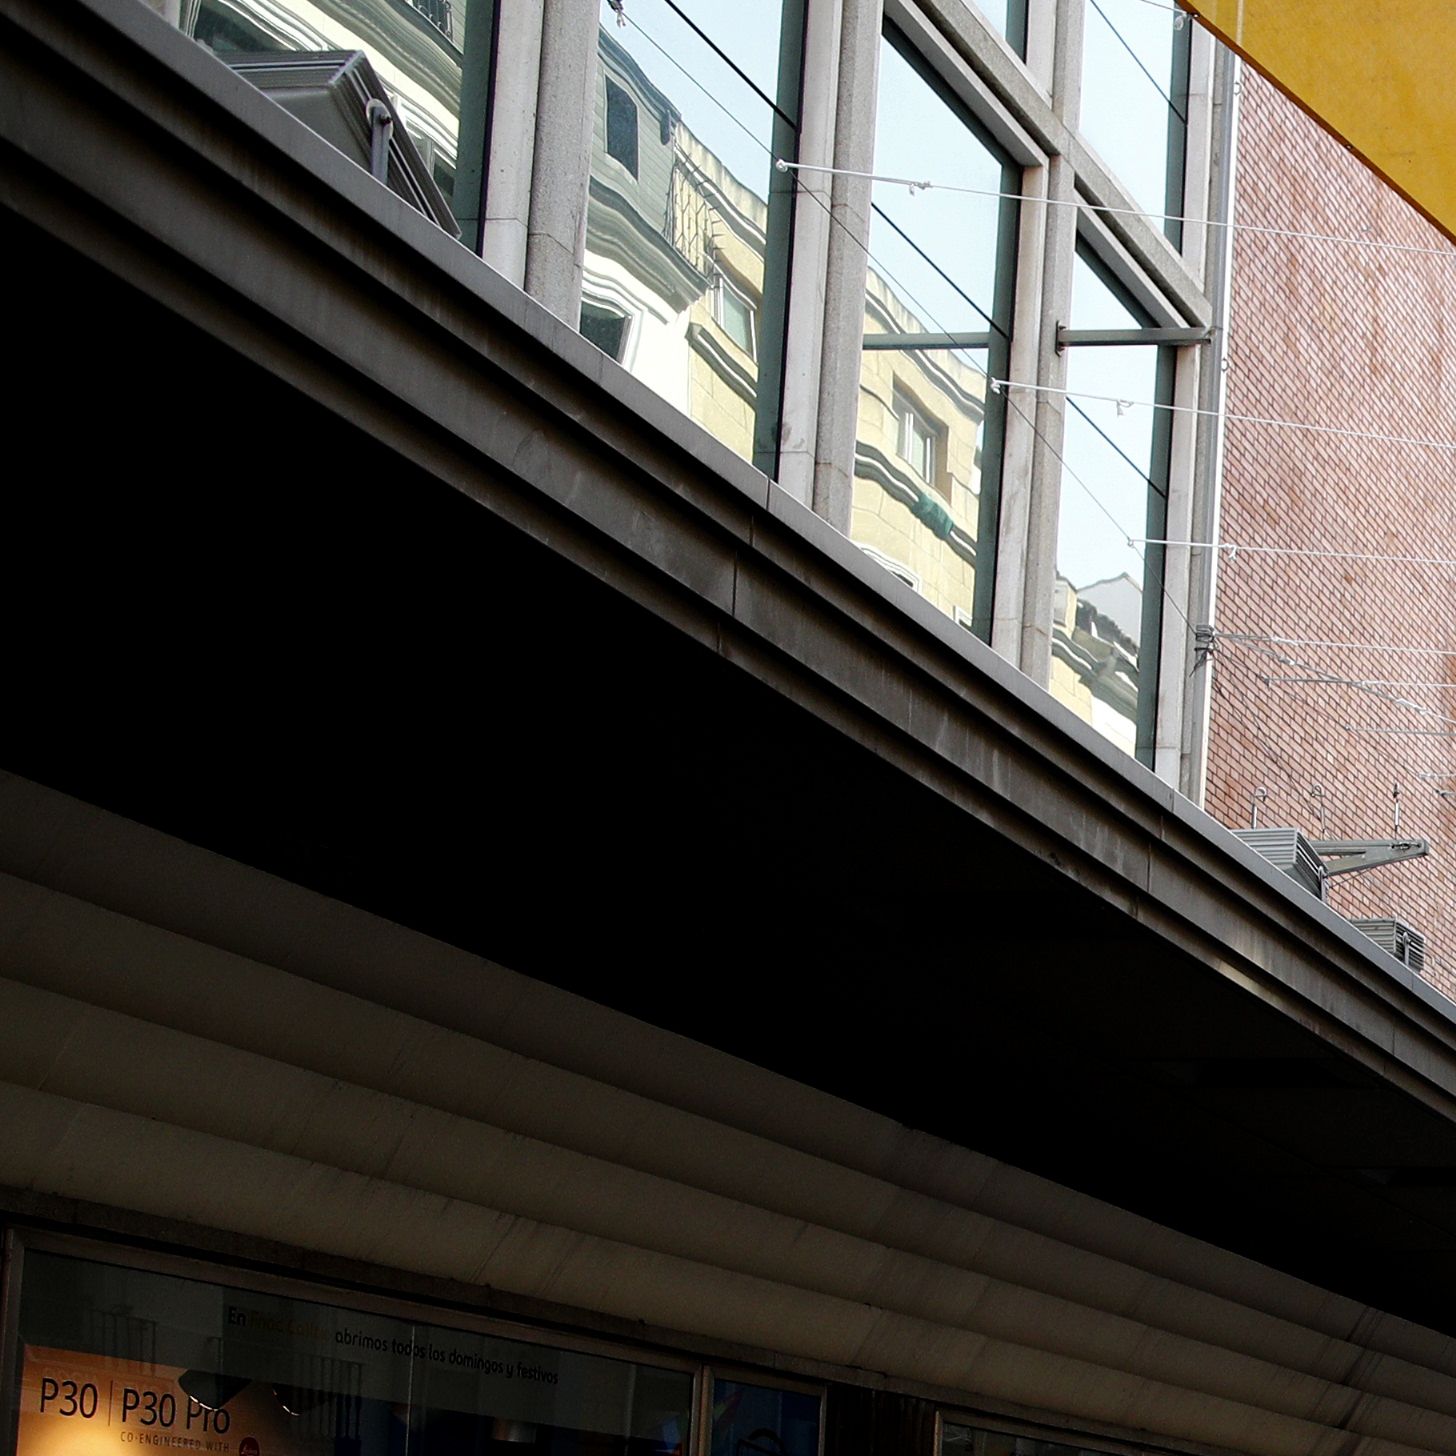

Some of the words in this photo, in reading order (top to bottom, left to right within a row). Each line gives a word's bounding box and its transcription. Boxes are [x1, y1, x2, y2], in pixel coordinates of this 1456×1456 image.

[335, 1330, 388, 1353] abrimos
[391, 1337, 425, 1360] todos
[429, 1344, 445, 1362] los
[449, 1348, 504, 1375] domingos
[506, 1362, 514, 1378] y
[517, 1361, 559, 1385] festivos
[41, 1377, 98, 1419] P30
[122, 1388, 175, 1427] P30
[187, 1403, 230, 1434] Pro
[206, 1440, 230, 1453] WITH
